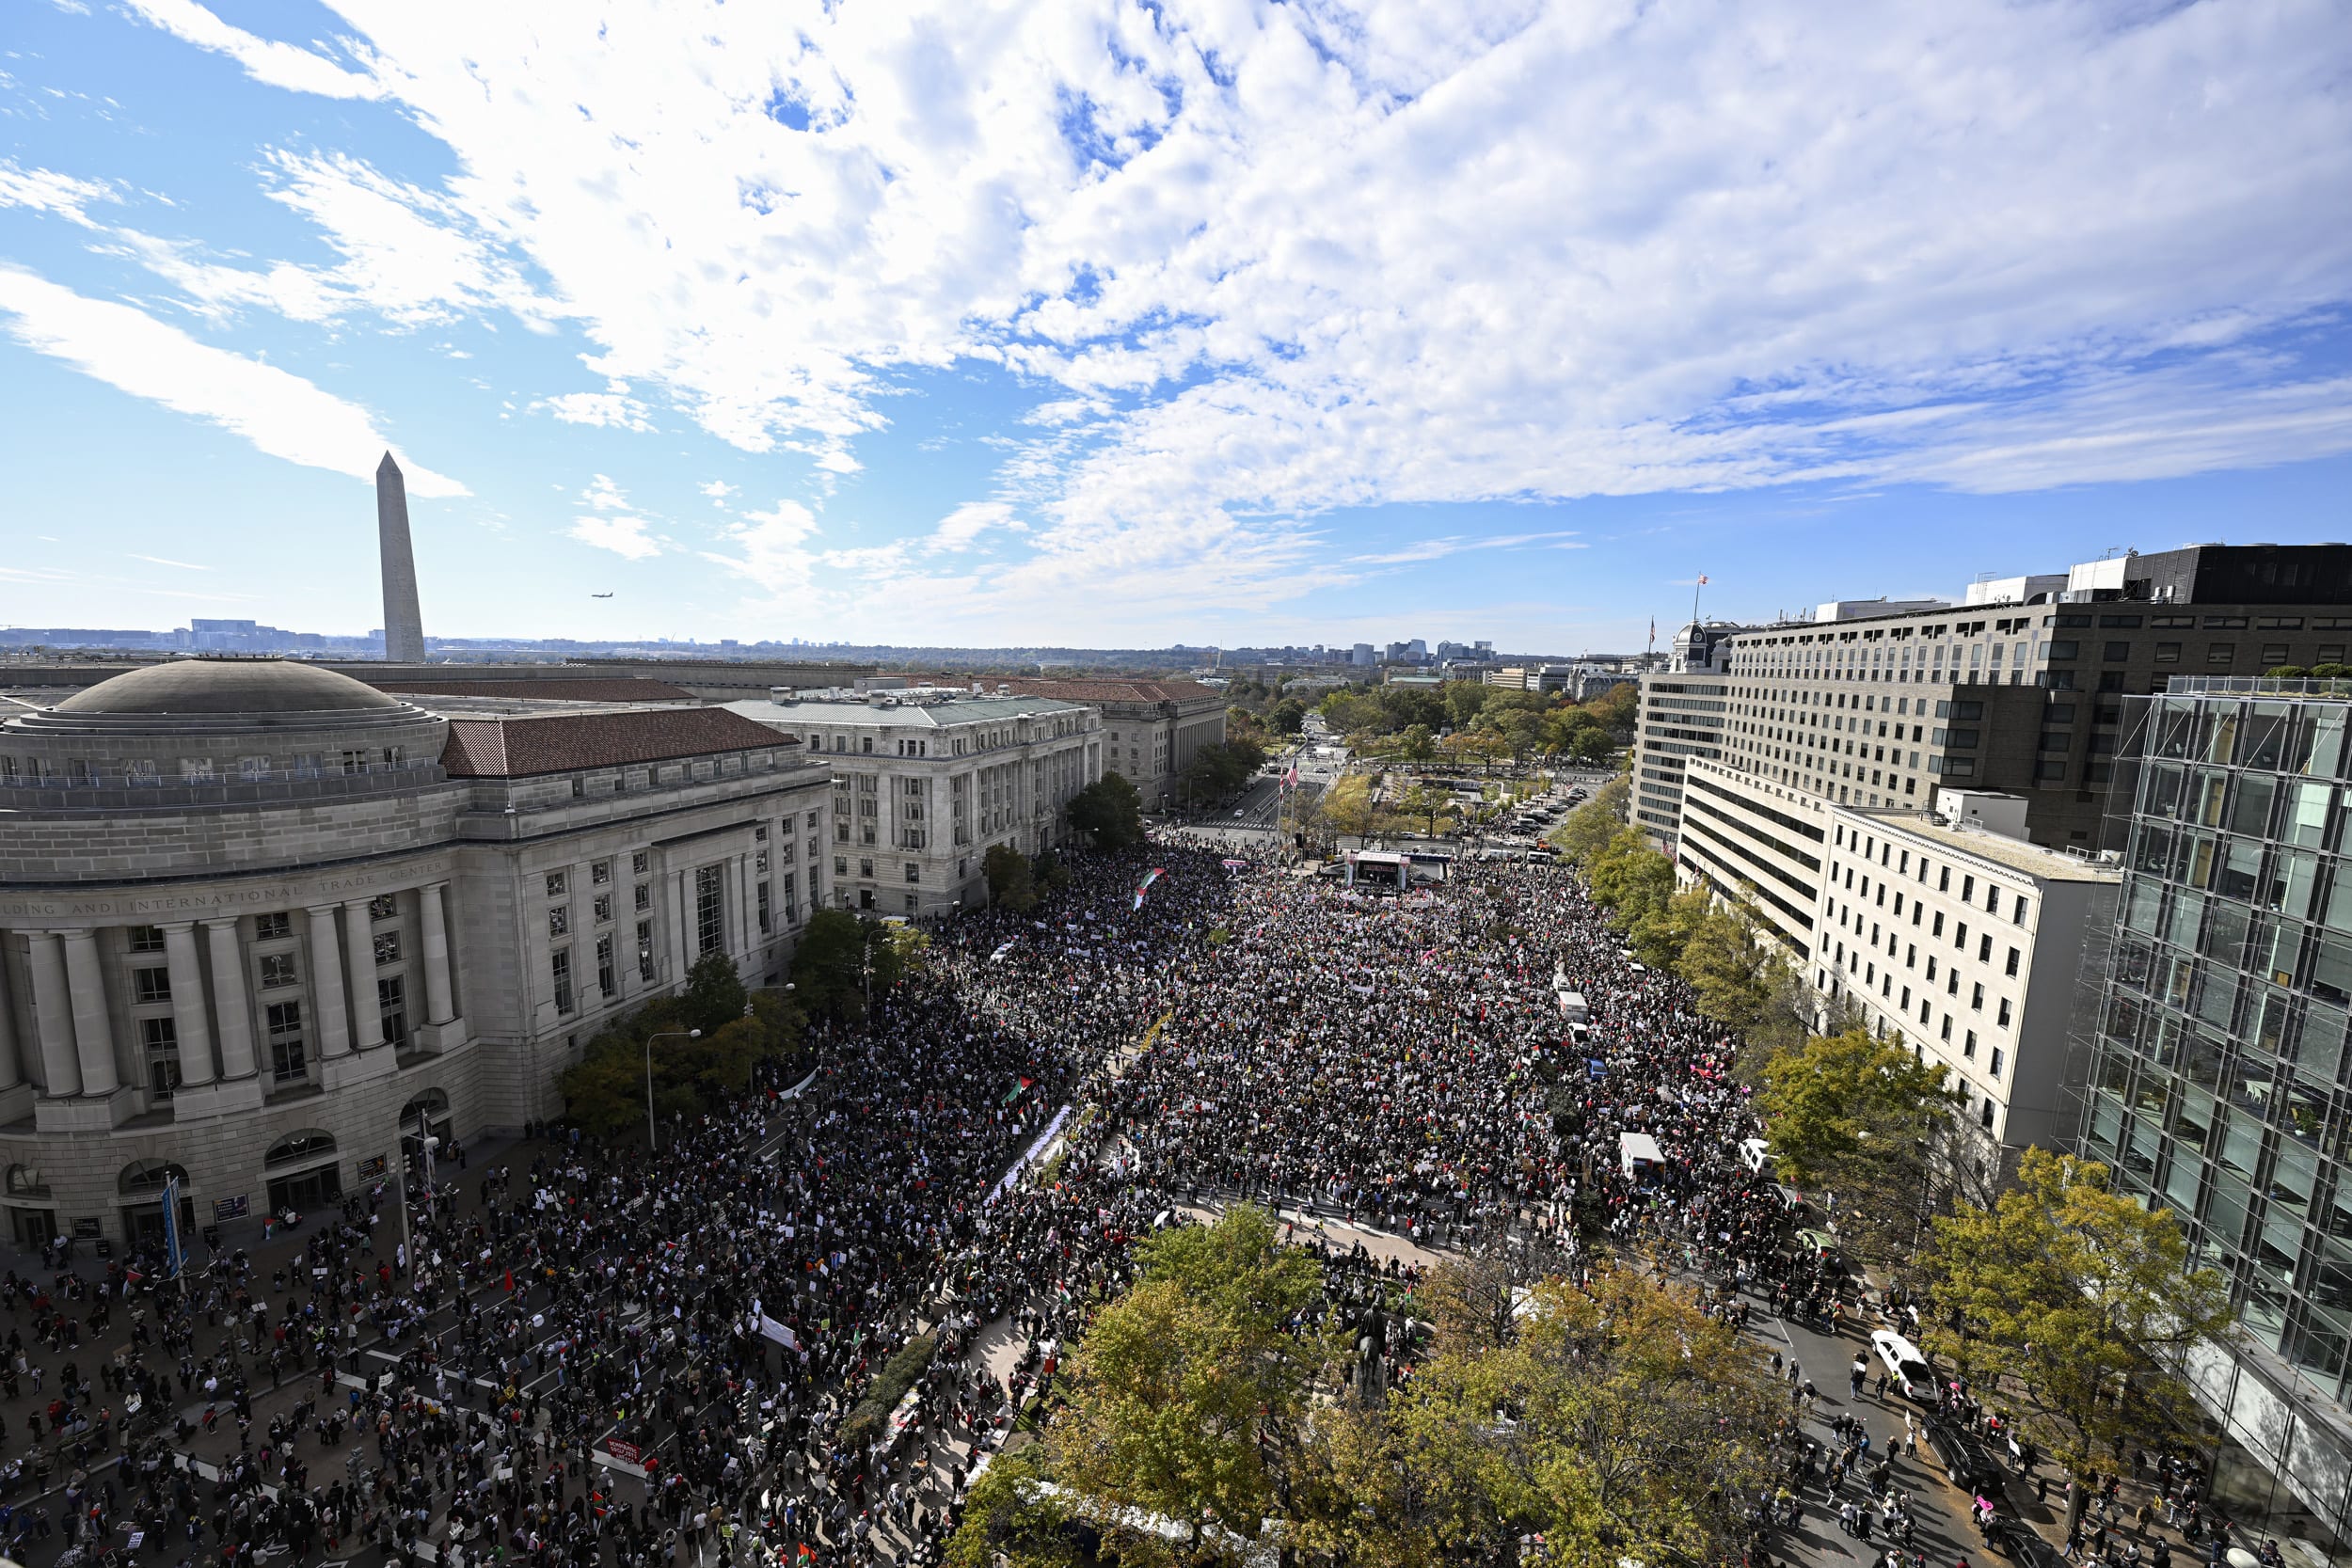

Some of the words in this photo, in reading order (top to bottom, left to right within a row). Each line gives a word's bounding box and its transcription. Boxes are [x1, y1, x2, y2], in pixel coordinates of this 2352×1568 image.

[72, 903, 111, 914] AND
[130, 886, 303, 911] INTERNATIONAL
[320, 876, 375, 891] TRADE
[389, 862, 442, 880] CENTER
